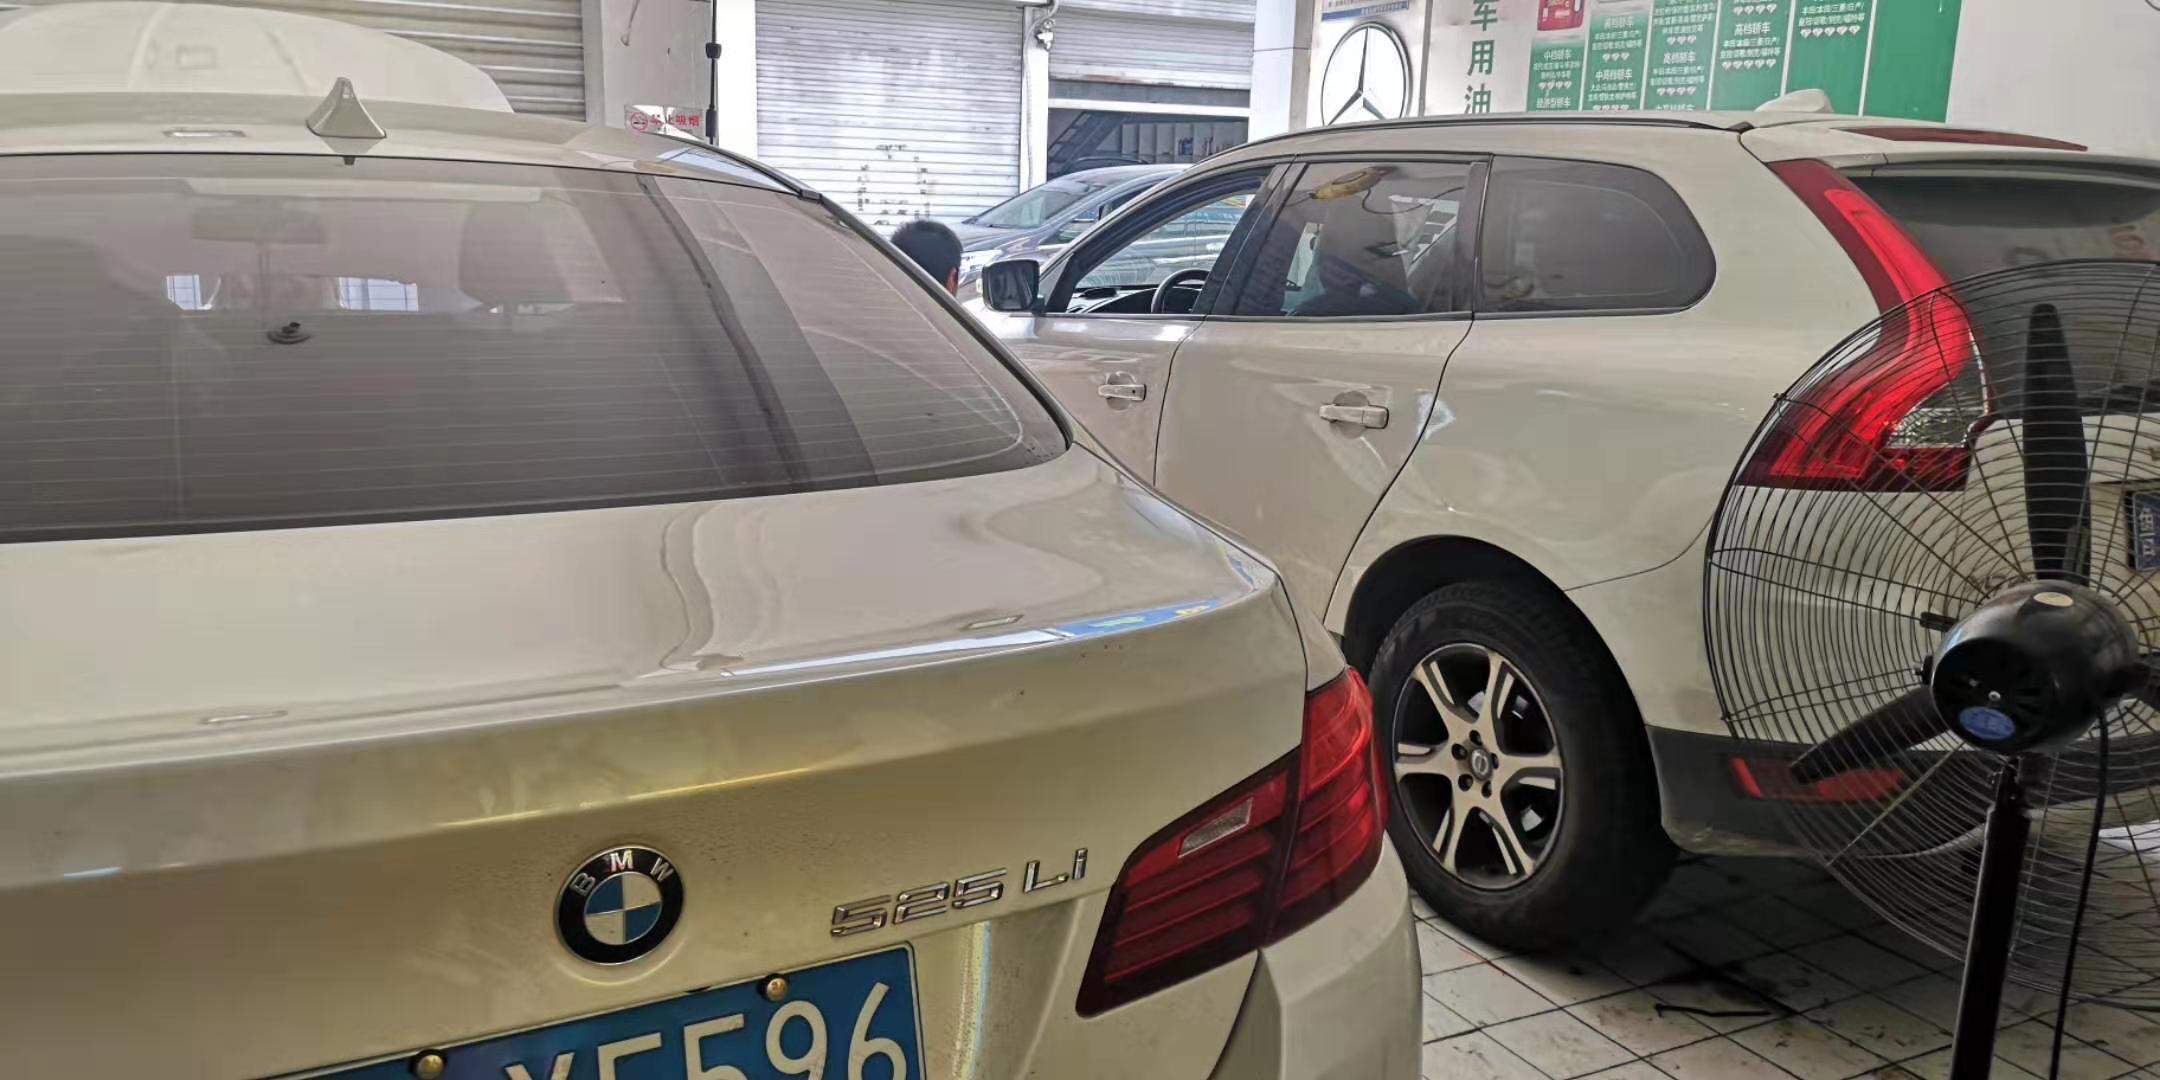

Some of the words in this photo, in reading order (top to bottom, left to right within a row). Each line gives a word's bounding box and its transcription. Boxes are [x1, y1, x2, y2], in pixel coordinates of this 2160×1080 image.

[1734, 22, 1771, 36] 高档轿车
[1664, 52, 1696, 64] 高档轿车
[1595, 69, 1633, 81] 中高档轿车
[831, 868, 1007, 937] 525
[1023, 847, 1089, 894] Li
[504, 982, 907, 1080] 596
